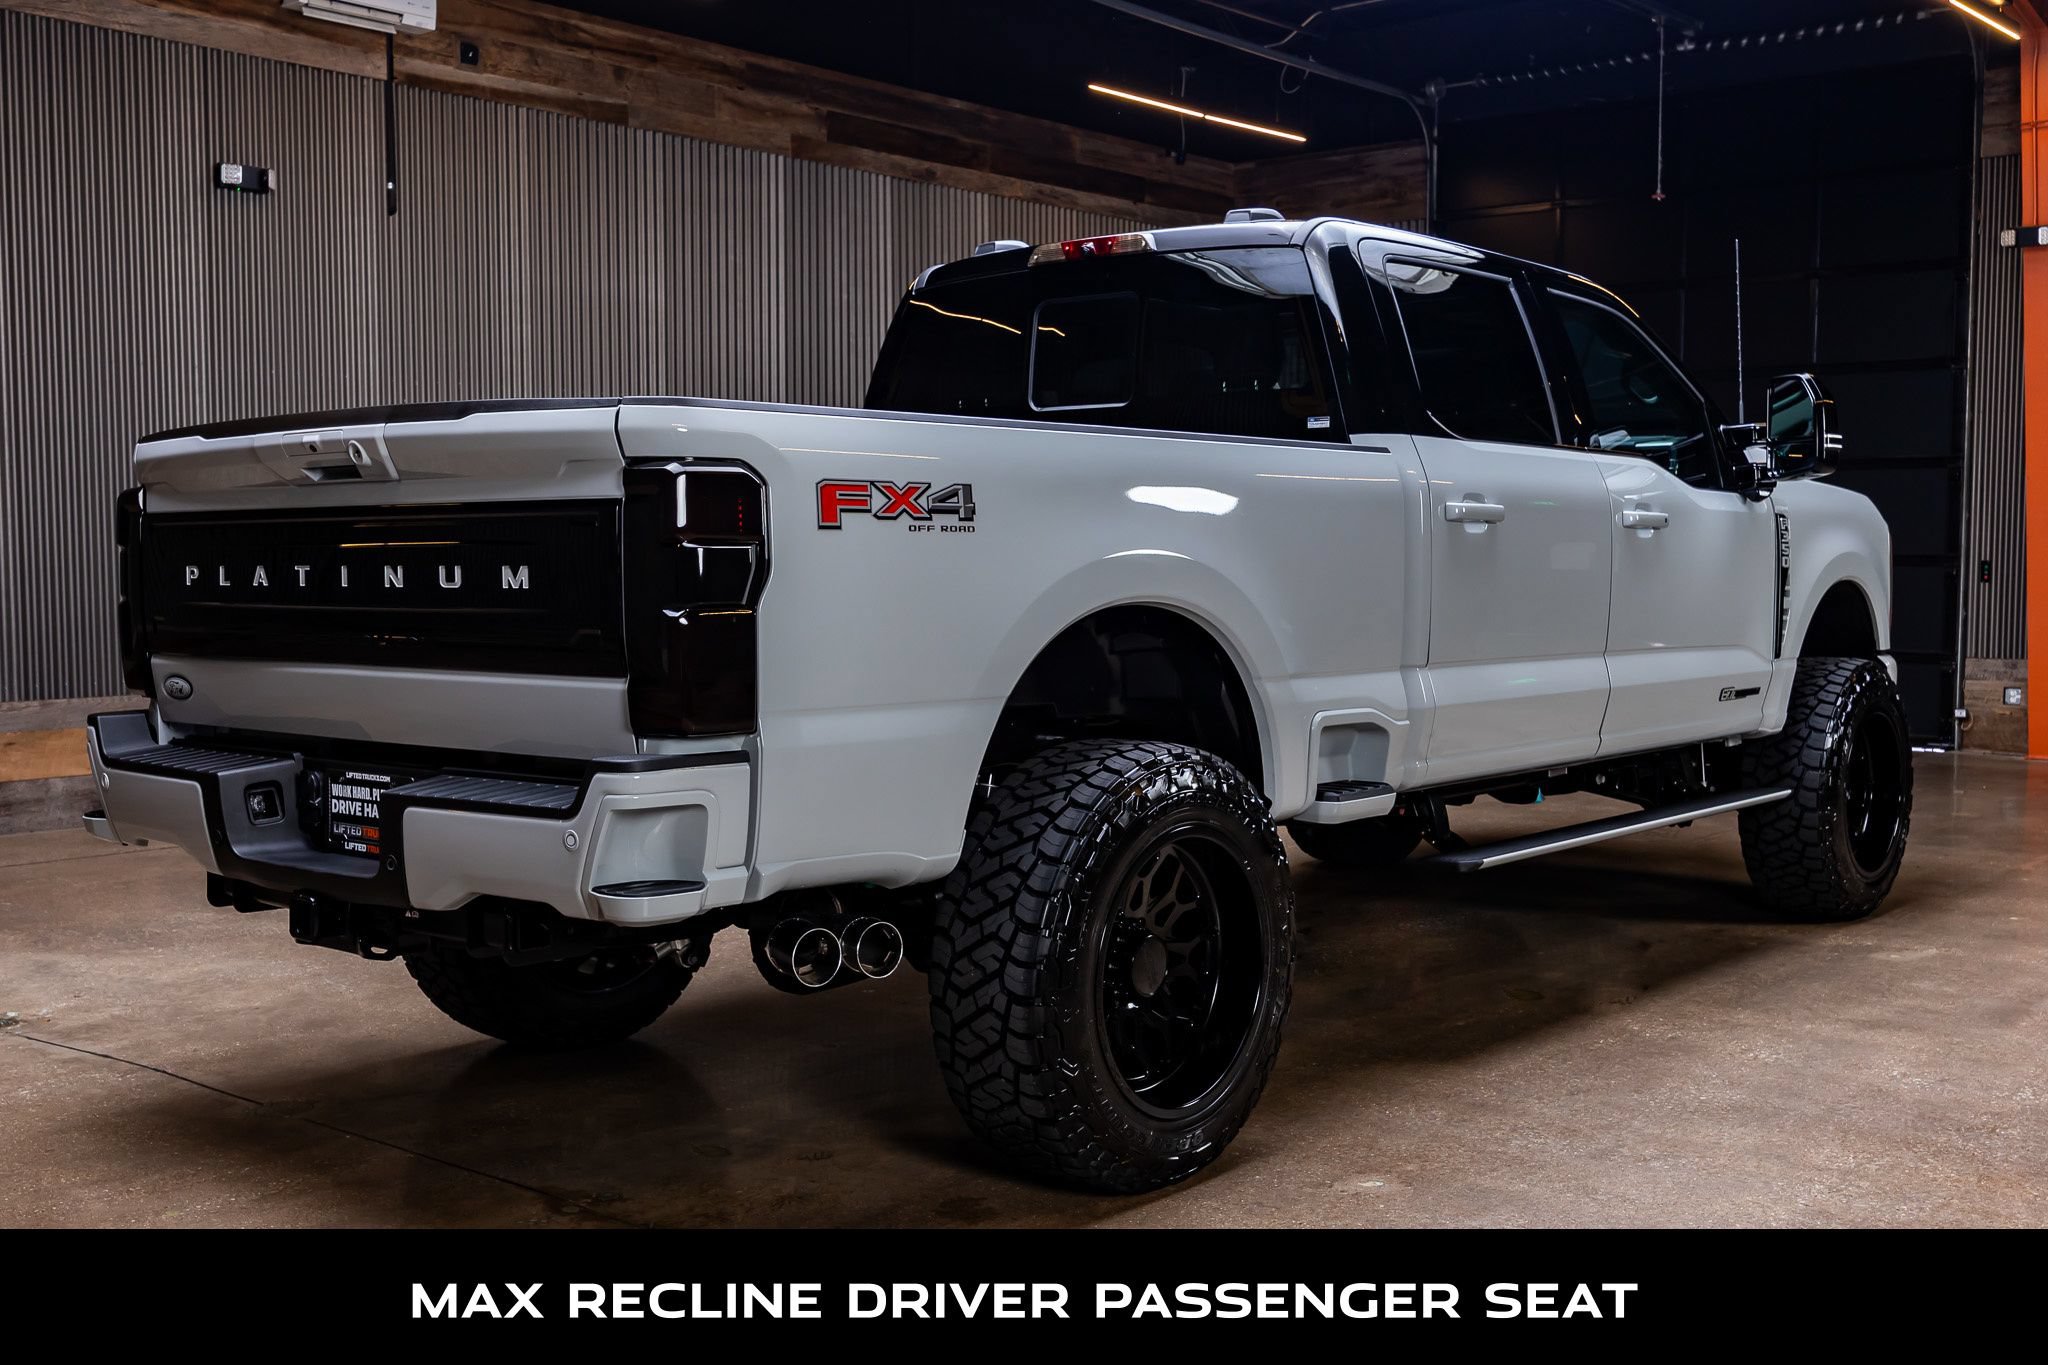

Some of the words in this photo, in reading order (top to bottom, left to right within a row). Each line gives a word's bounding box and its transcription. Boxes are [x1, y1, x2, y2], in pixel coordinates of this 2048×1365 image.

[815, 478, 976, 531] FX4
[908, 524, 936, 532] OFF
[941, 525, 976, 533] ROAD
[185, 564, 529, 589] PLATINUM
[331, 783, 352, 798] WORK
[352, 785, 372, 800] HARD.
[331, 798, 362, 817] DRIVE
[363, 802, 380, 819] HA
